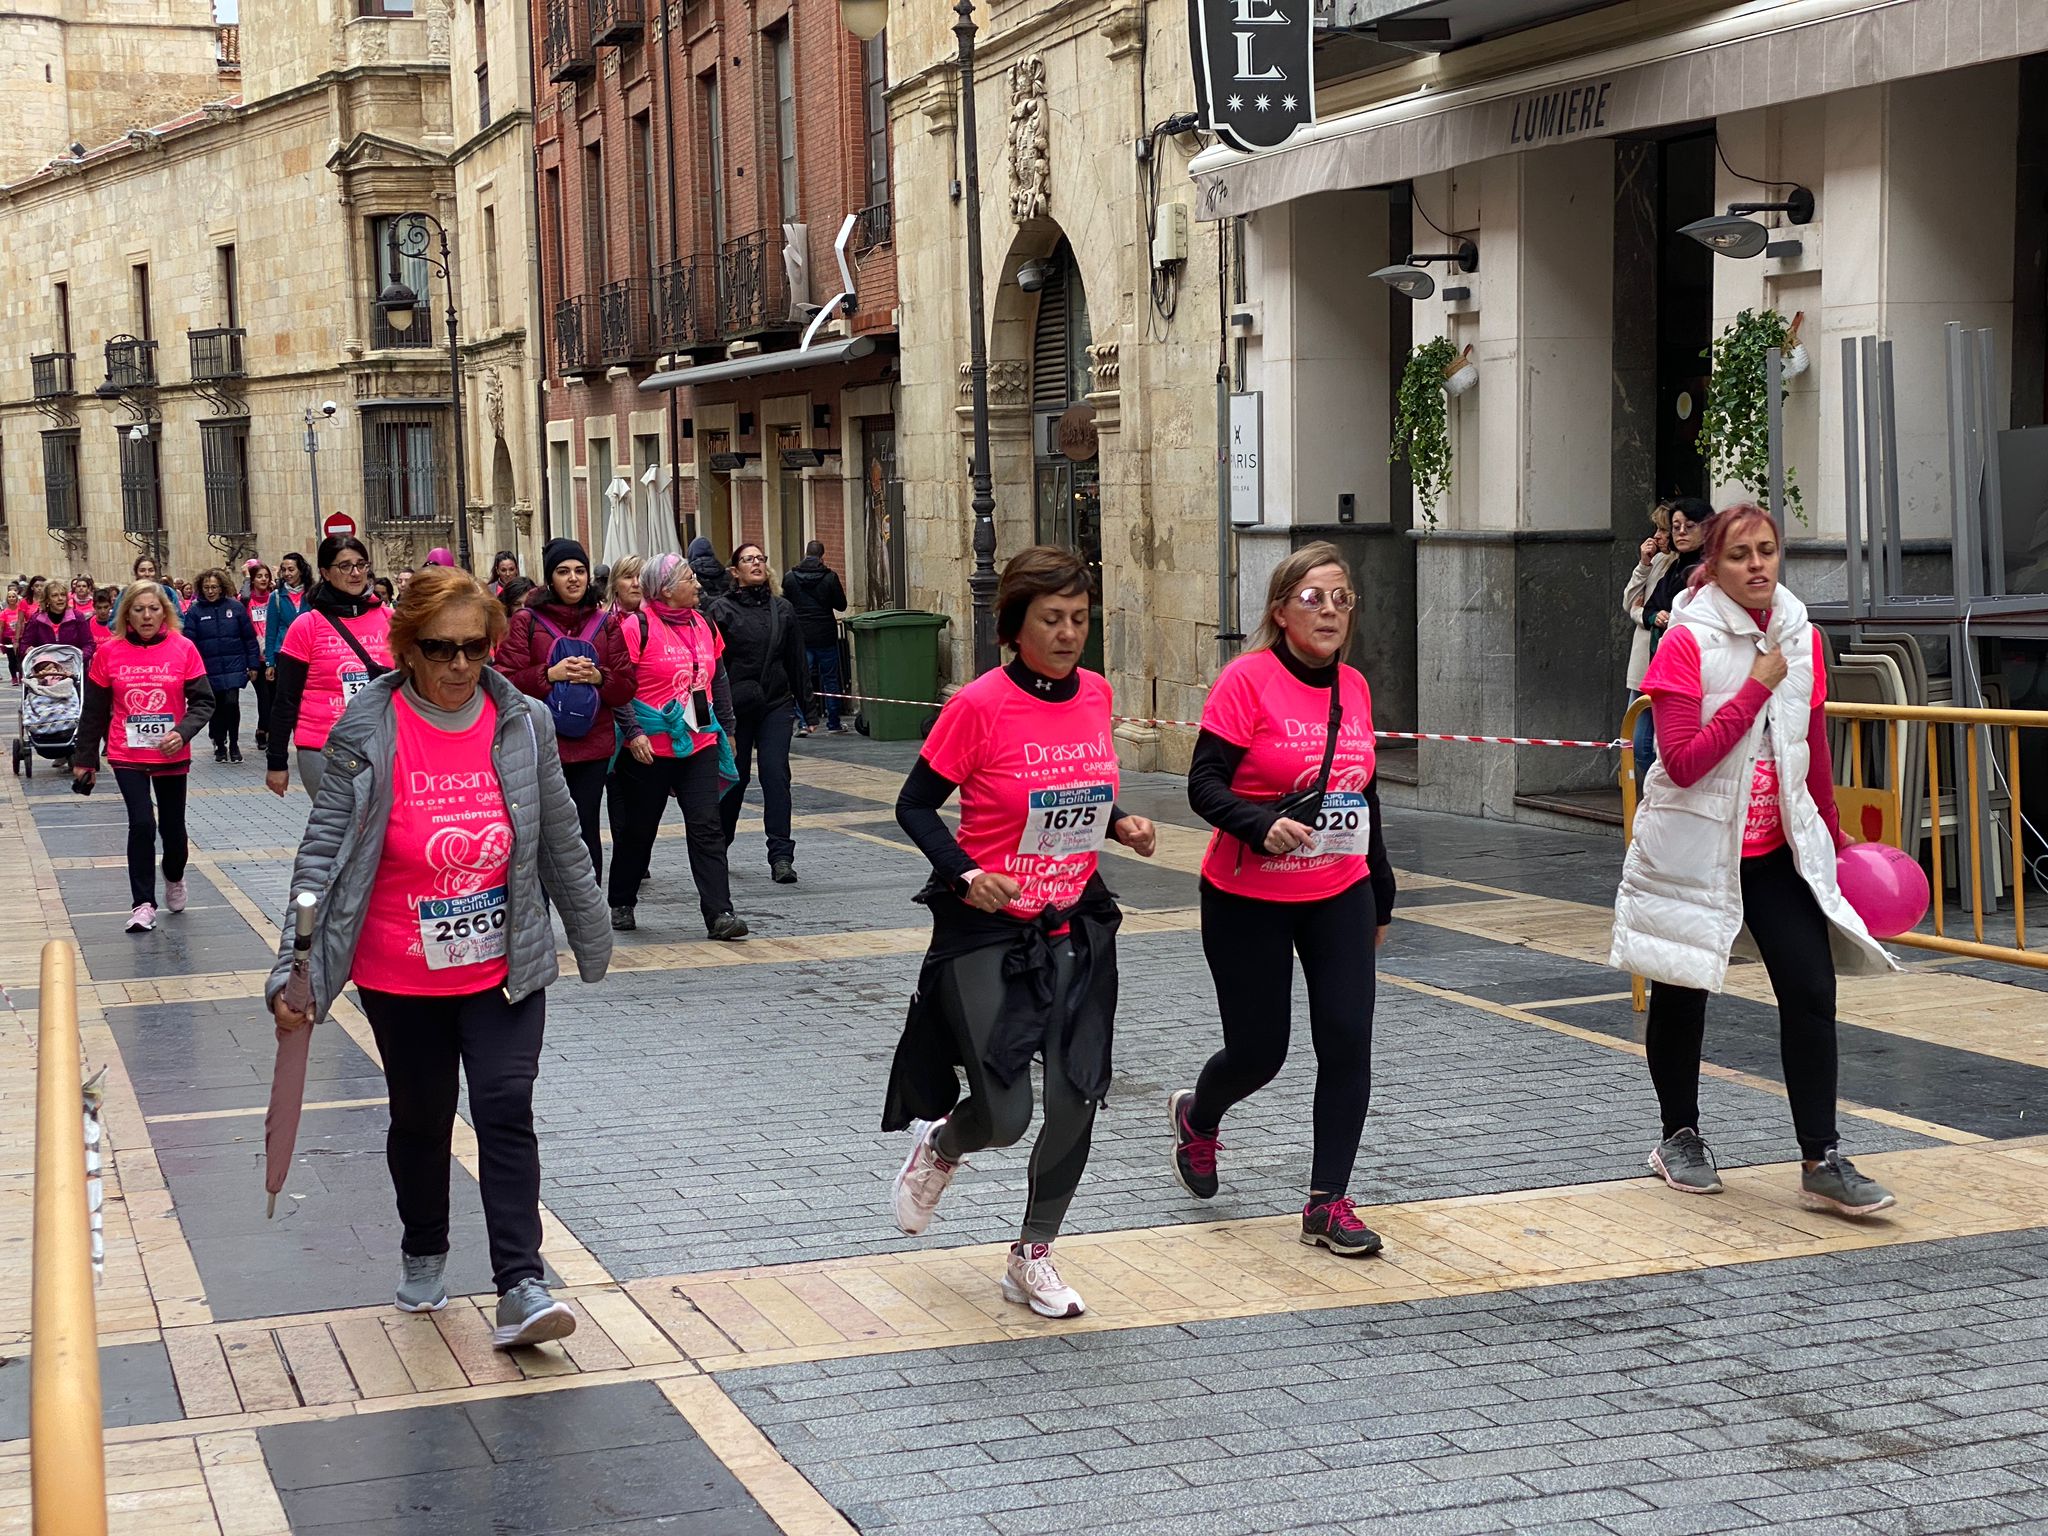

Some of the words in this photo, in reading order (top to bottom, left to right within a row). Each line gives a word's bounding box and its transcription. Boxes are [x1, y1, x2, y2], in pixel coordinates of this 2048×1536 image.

[1511, 82, 1611, 144] LUMIERE
[135, 723, 166, 734] 1461
[1014, 765, 1075, 779] VIGOREE
[411, 771, 499, 794] Drasanv
[1060, 788, 1091, 797] GRUPO
[1321, 799, 1360, 808] olitium
[1044, 806, 1098, 830] 1675
[1312, 811, 1359, 831] 020
[451, 892, 489, 906] GRUPO
[435, 909, 506, 942] 2660
